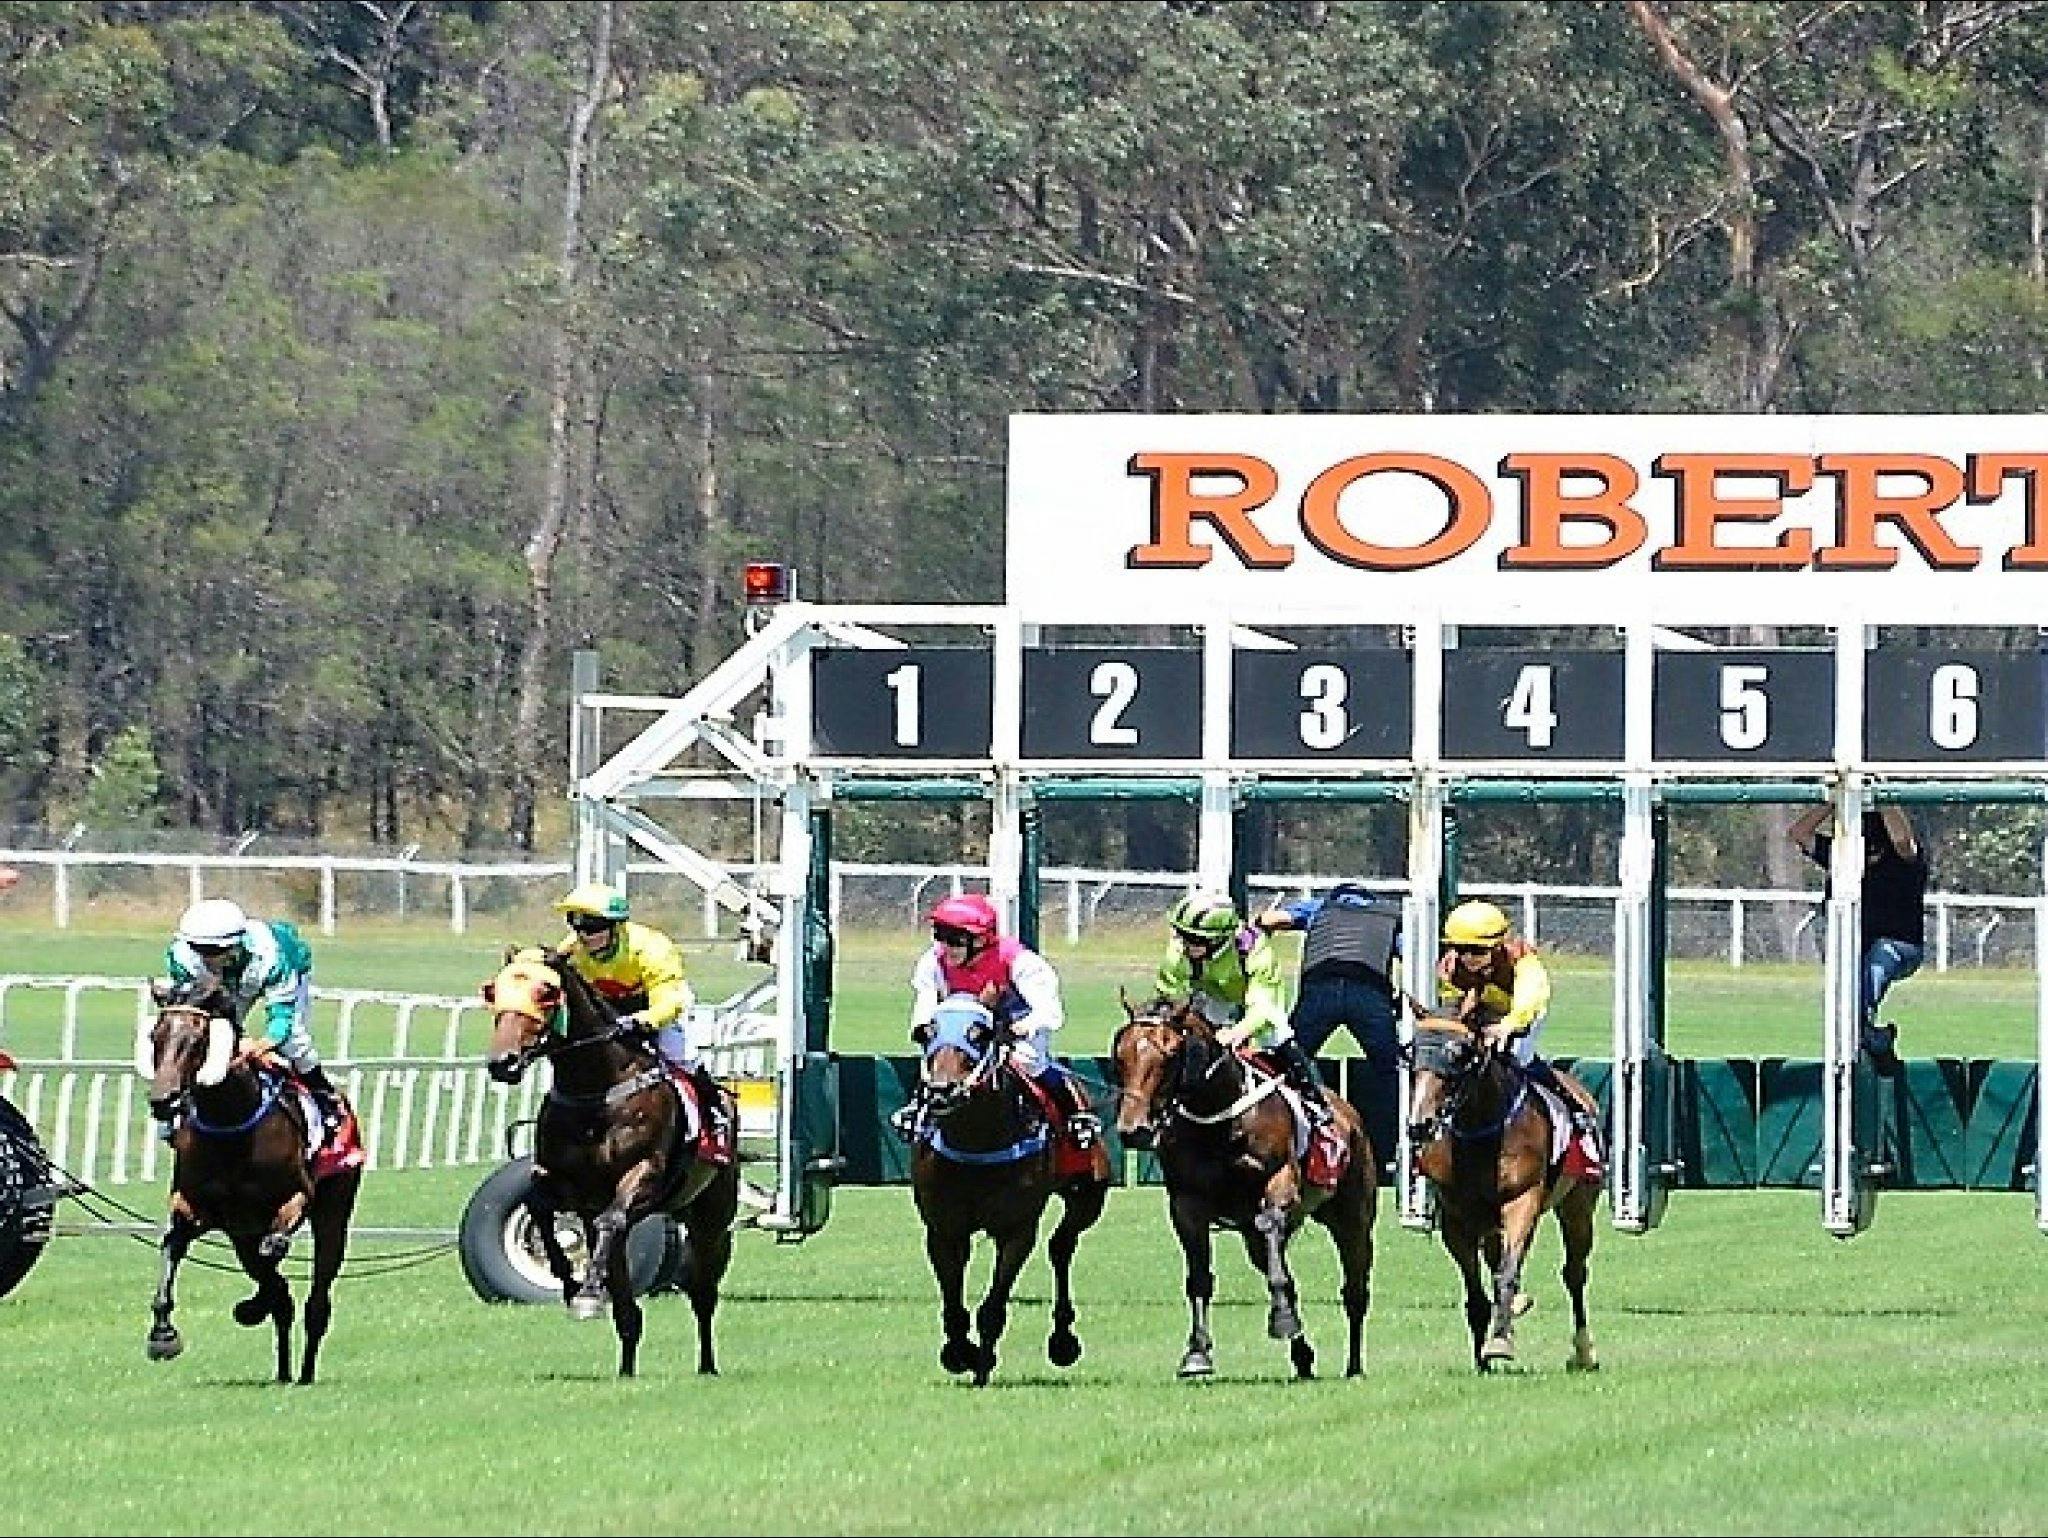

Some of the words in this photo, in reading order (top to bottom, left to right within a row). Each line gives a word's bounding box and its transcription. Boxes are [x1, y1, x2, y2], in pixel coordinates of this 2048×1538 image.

[886, 664, 919, 747] 1
[1089, 661, 1139, 745] 2
[1299, 664, 1349, 749] 3
[1501, 664, 1558, 748] 4
[1719, 664, 1769, 749] 5
[1929, 664, 1979, 749] 6
